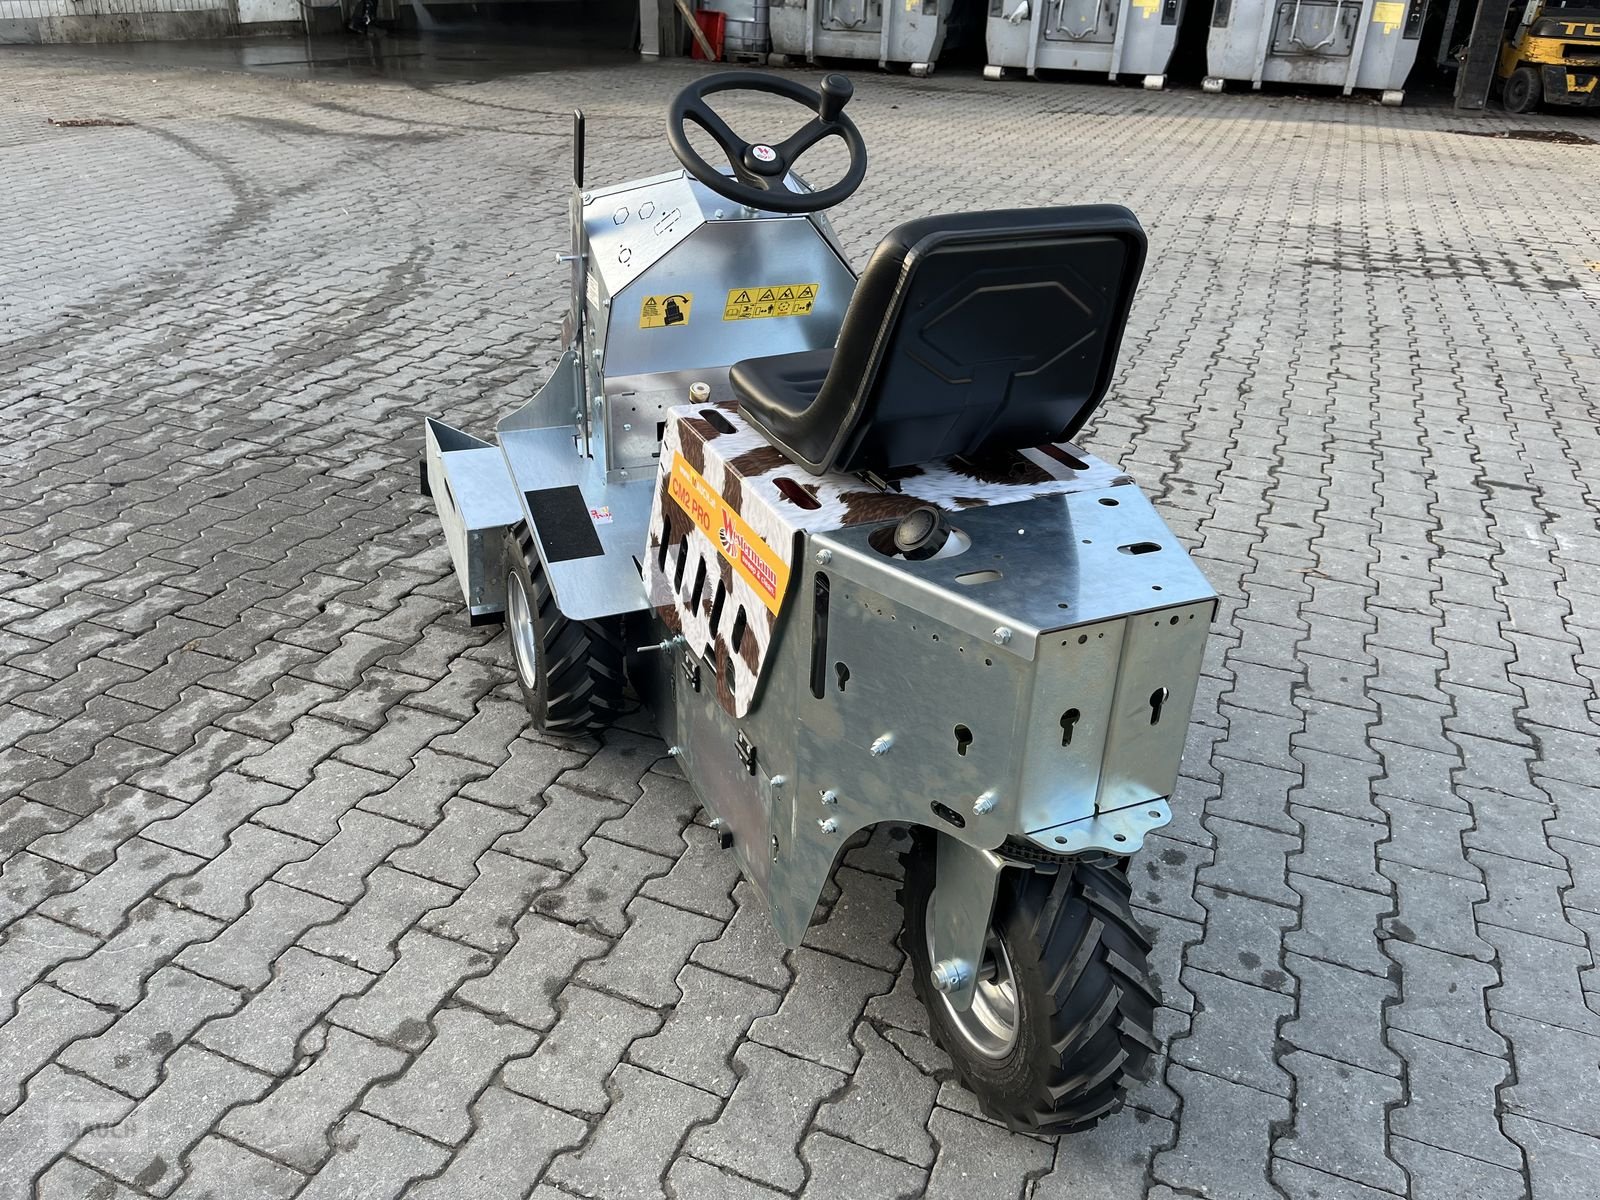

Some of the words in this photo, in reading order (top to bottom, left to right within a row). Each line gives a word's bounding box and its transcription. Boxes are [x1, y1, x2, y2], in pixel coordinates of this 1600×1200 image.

[672, 477, 690, 509] CM2
[692, 499, 711, 530] PRO
[721, 506, 777, 586] Westermann
